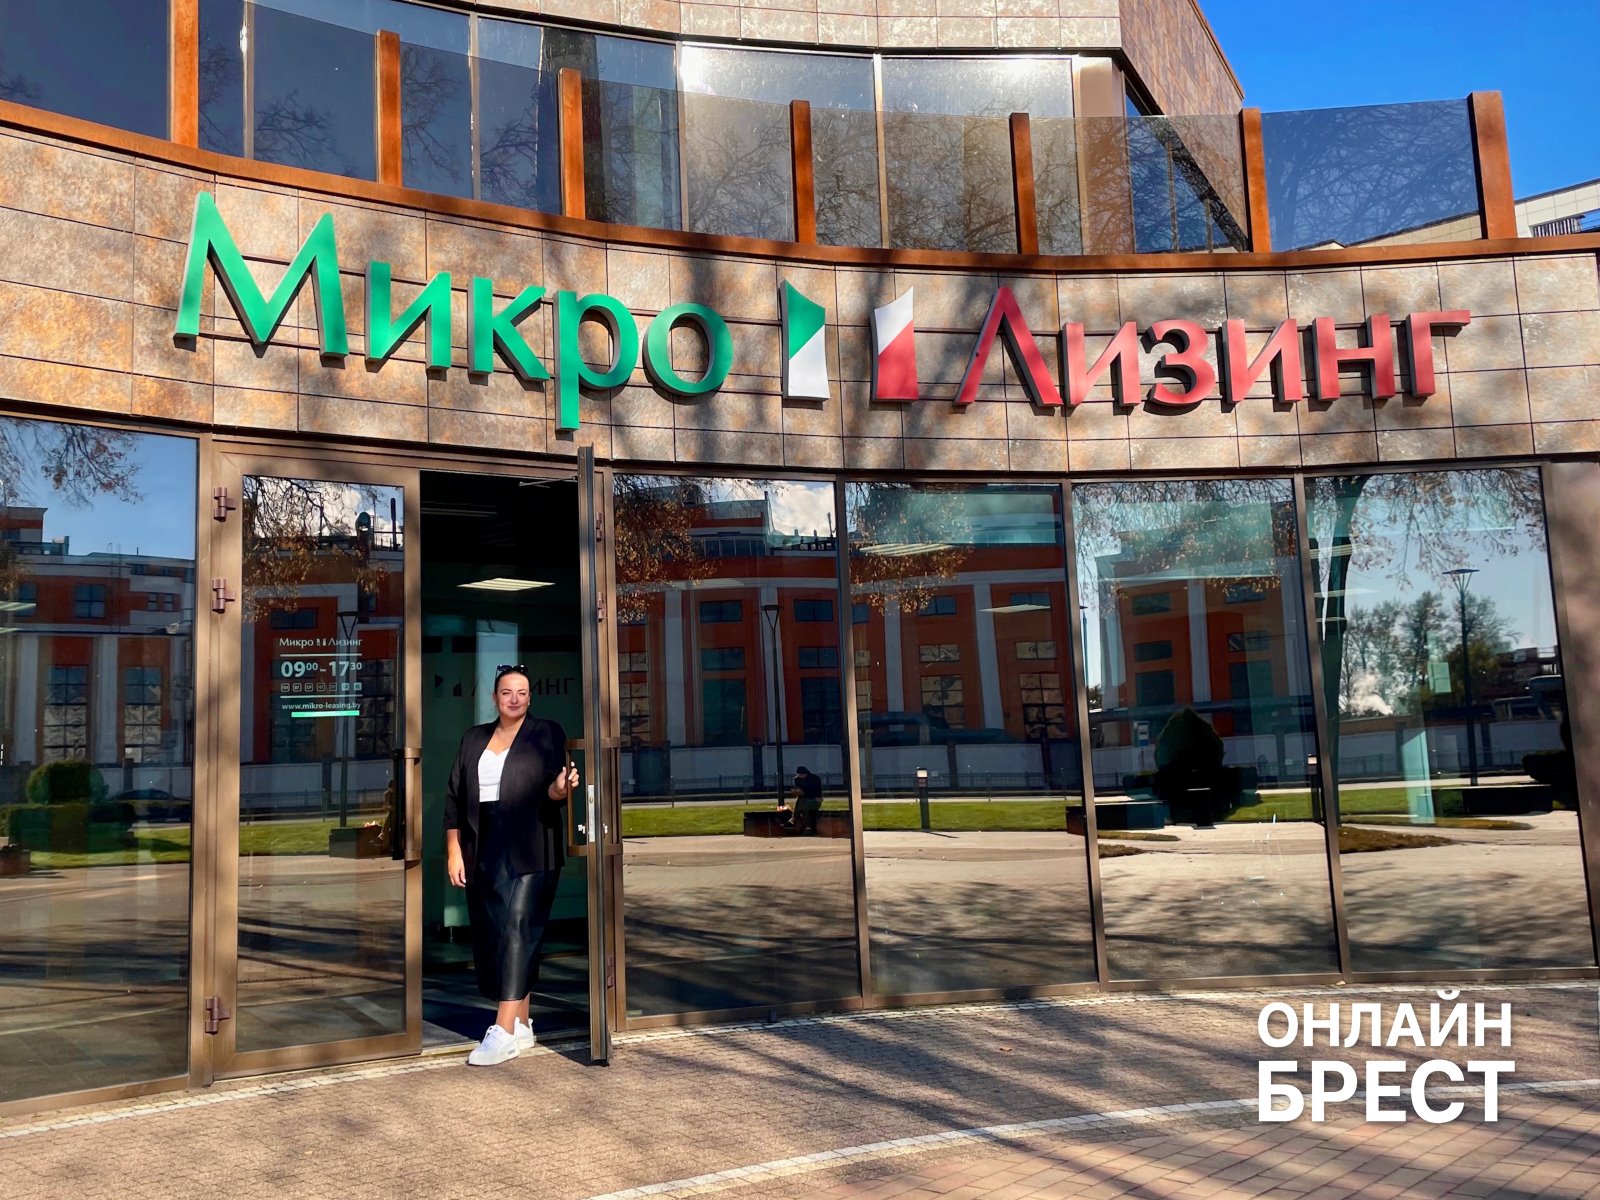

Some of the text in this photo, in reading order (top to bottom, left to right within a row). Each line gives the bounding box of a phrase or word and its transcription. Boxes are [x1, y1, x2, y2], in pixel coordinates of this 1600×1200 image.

[173, 190, 1471, 431] Микро Лизинг
[280, 637, 363, 649] Микро Лизинг
[281, 701, 361, 710] www.mikro-leasing.by
